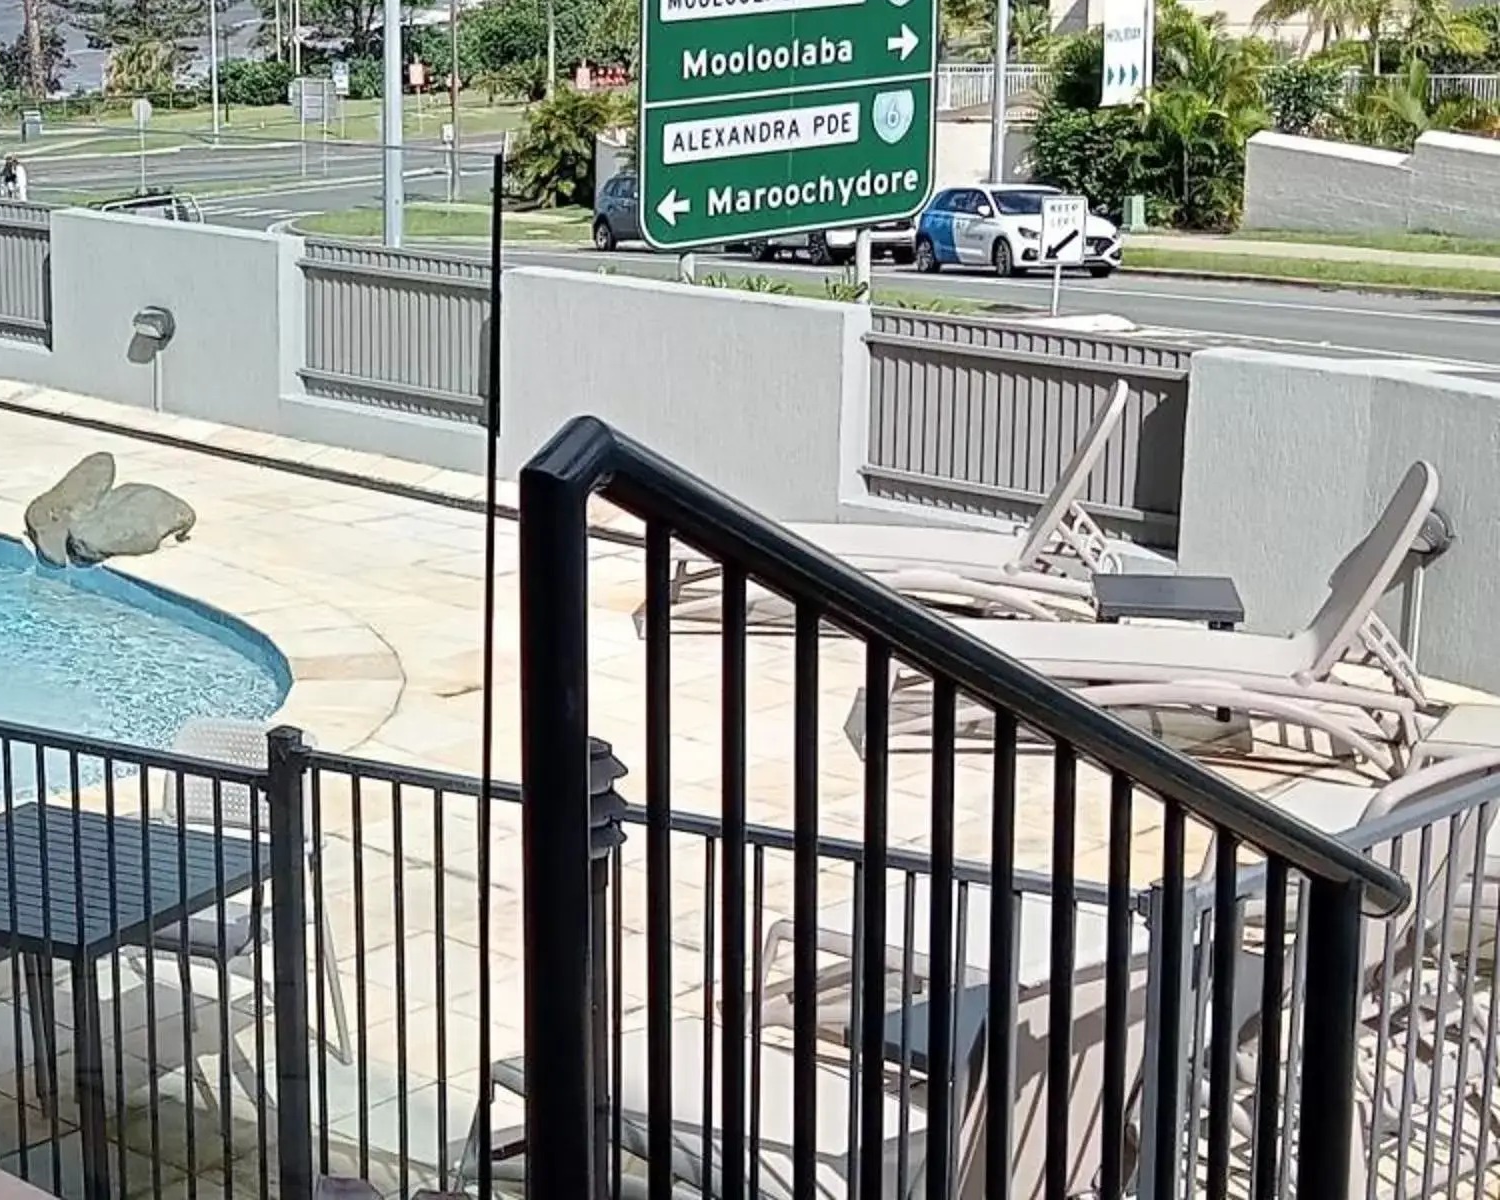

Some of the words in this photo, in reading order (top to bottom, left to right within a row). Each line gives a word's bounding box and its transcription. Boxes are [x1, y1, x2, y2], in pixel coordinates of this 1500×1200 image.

[682, 36, 854, 80] Mooloolaba
[672, 120, 801, 152] ALEXANDRA
[813, 111, 853, 135] PDE
[707, 168, 919, 217] Maroochydore
